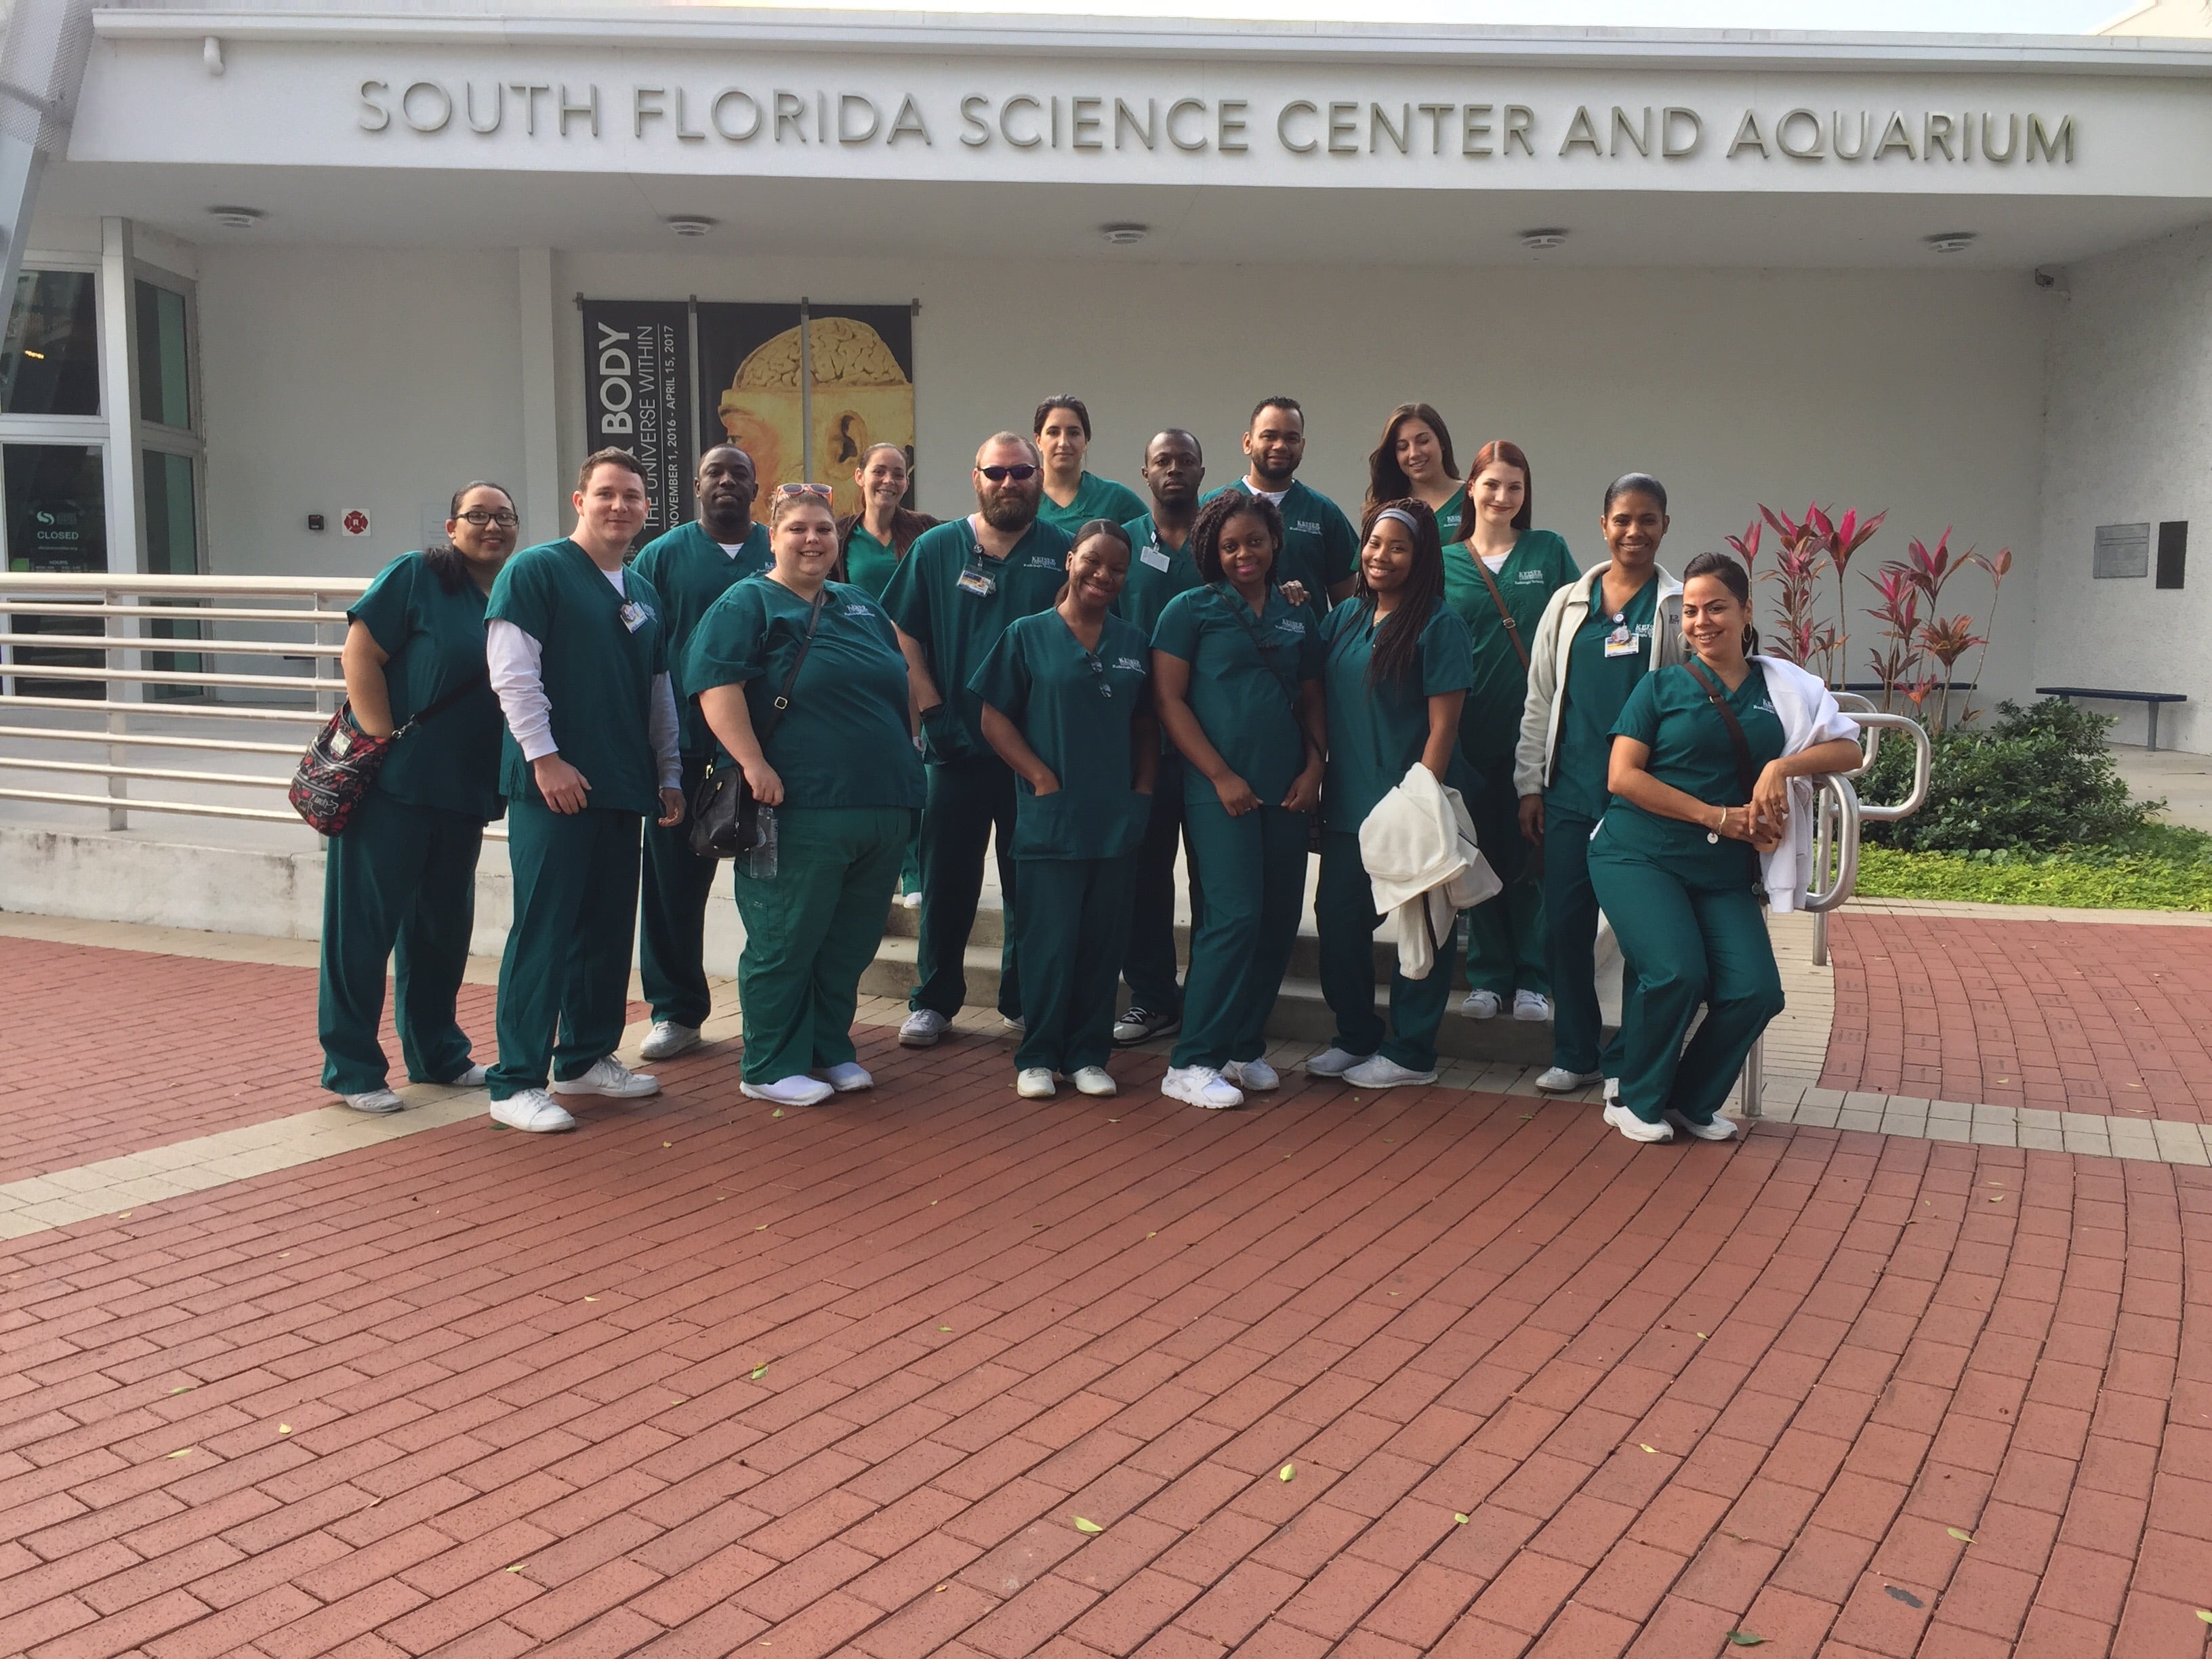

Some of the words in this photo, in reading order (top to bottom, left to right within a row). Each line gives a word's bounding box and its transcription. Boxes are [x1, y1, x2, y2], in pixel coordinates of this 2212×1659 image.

[359, 79, 598, 138] SOUTH
[633, 83, 933, 146] FLORIDA
[959, 92, 1250, 152] SCIENCE
[1277, 100, 1535, 156] CENTER
[1559, 105, 1704, 159] AND
[1726, 108, 2075, 164] AQUARIUM
[663, 325, 674, 353] 2017
[637, 325, 655, 393] WITHIN
[665, 356, 676, 374] 15,
[597, 321, 633, 434] BODY
[665, 376, 676, 410] APRIL
[640, 398, 658, 490] UNIVERSE
[667, 419, 677, 447] 2016
[668, 451, 678, 461] 1,
[643, 496, 659, 530] THE
[668, 464, 680, 529] NOVEMBER
[37, 531, 79, 540] CLOSED
[352, 518, 359, 527] R
